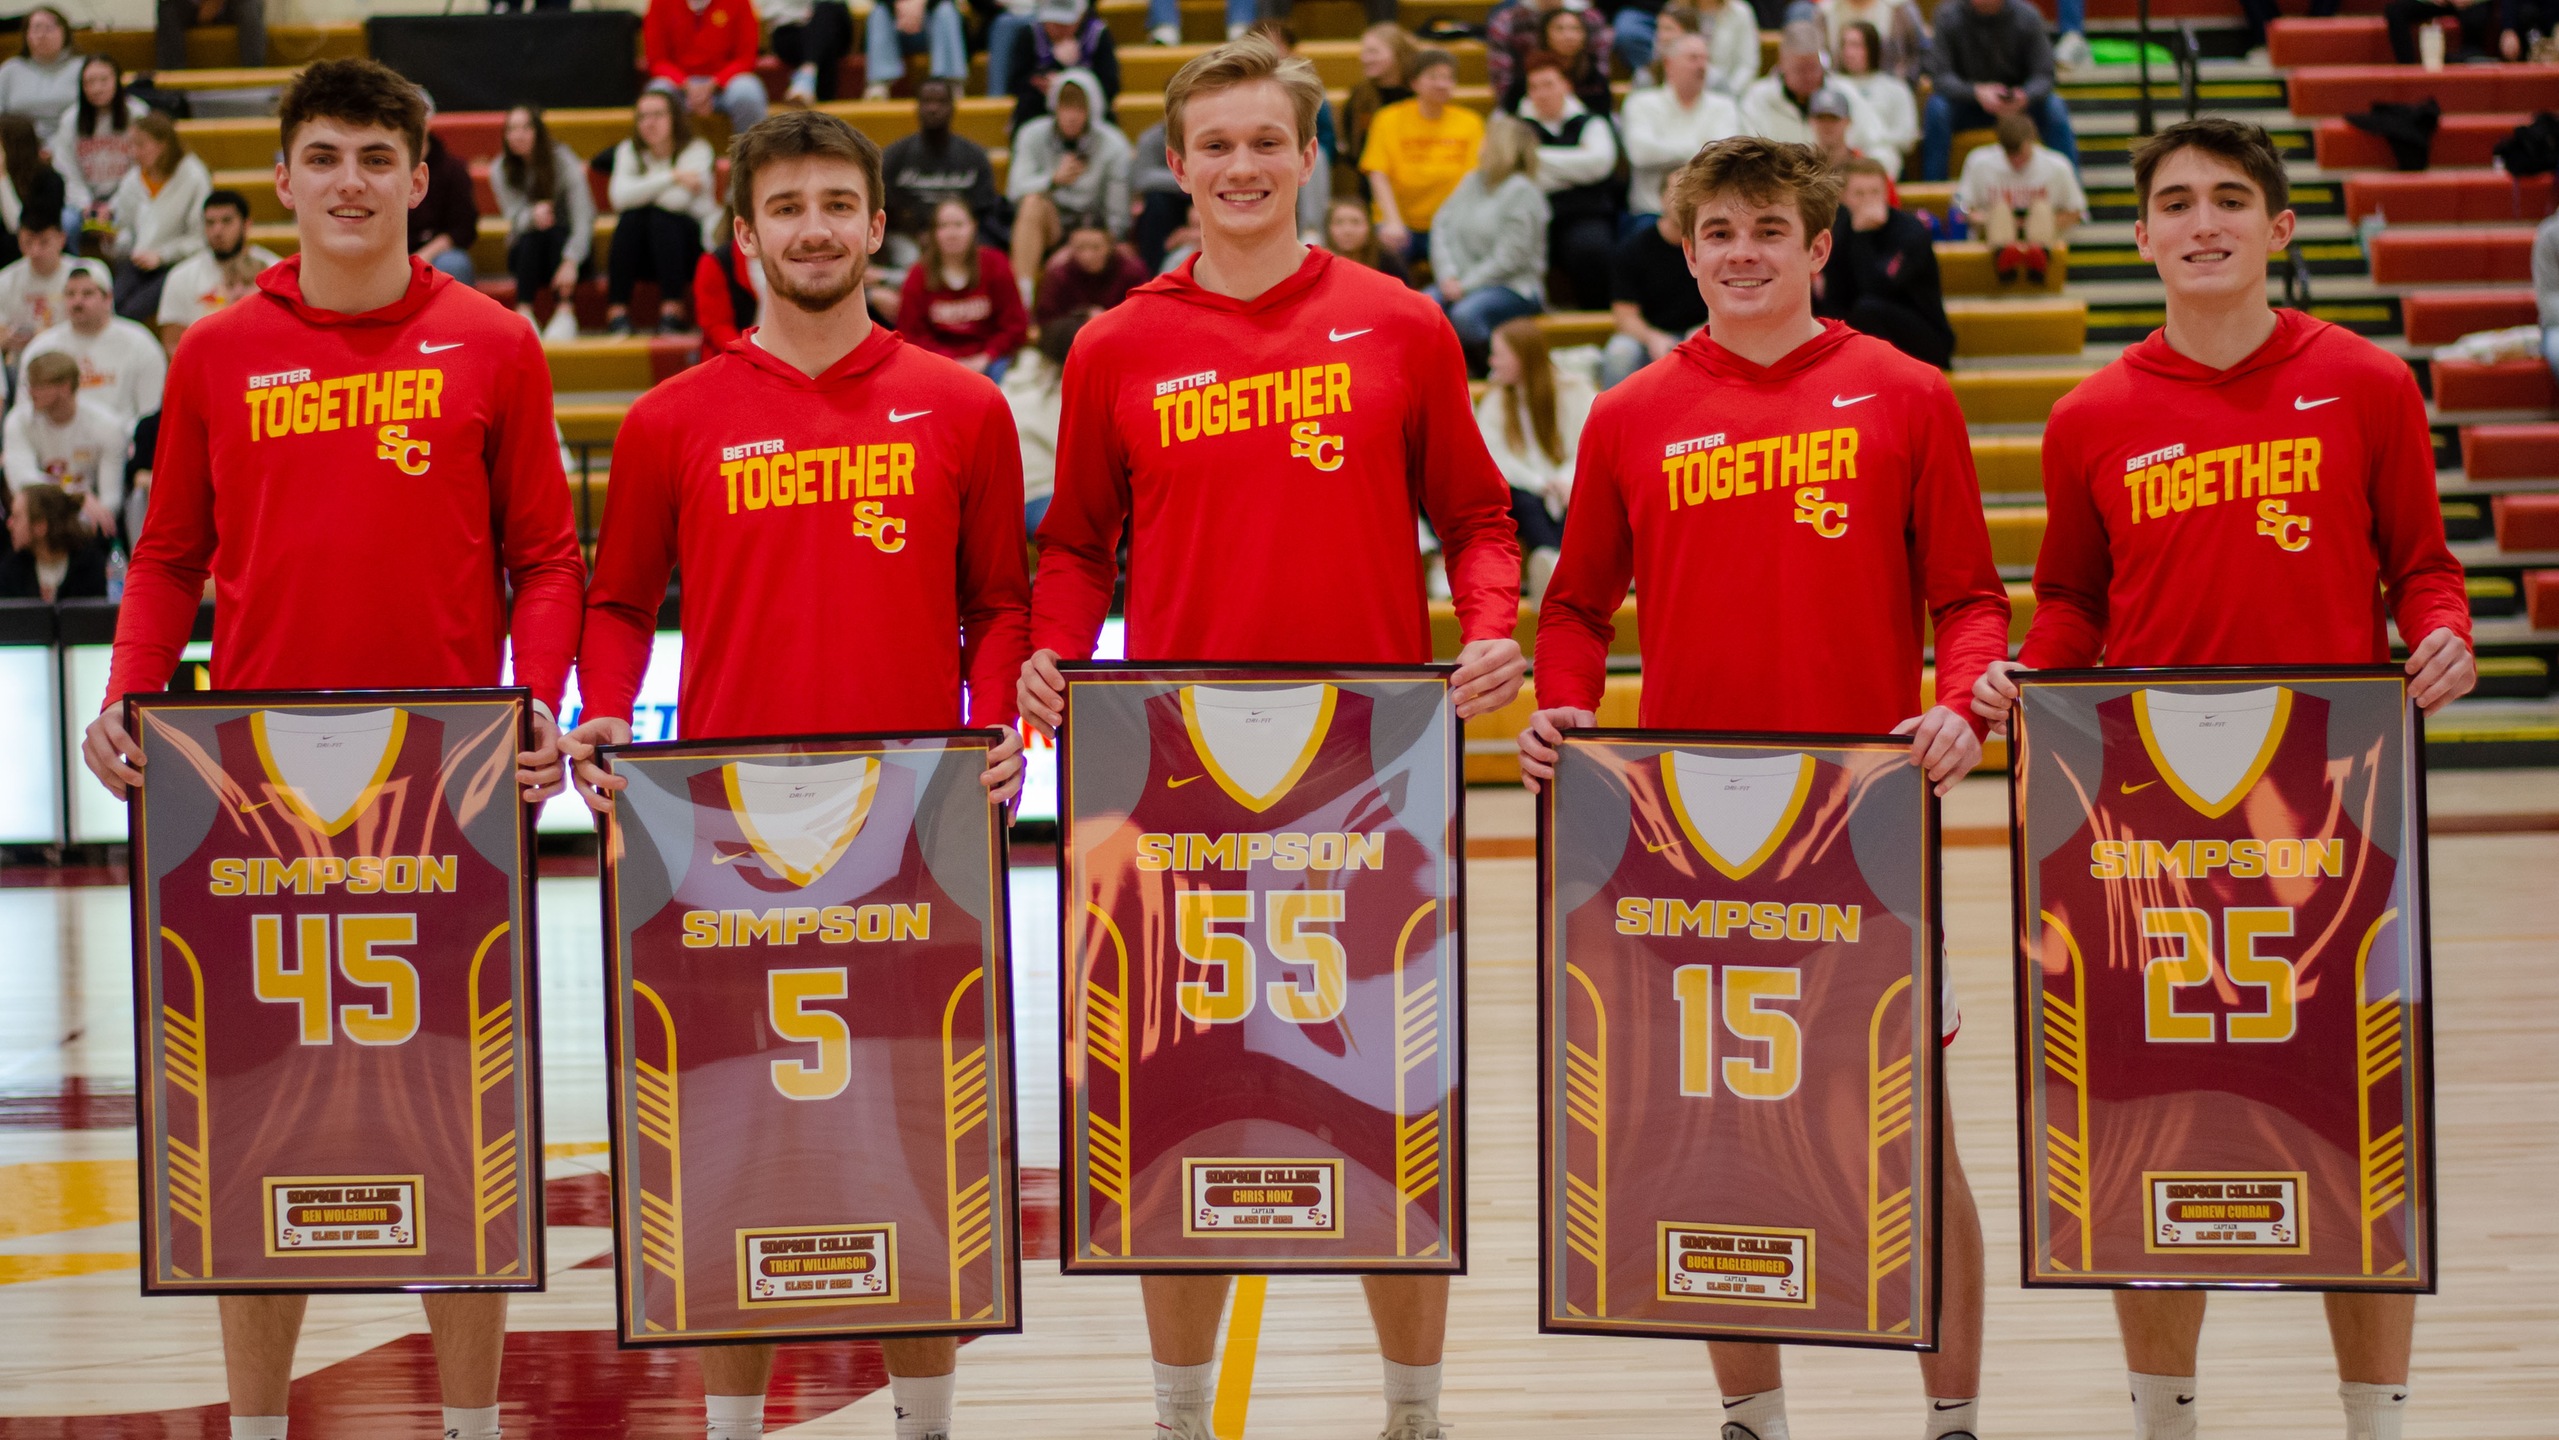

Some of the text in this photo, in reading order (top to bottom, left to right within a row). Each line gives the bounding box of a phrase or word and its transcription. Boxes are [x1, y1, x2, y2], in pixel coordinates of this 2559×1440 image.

[249, 368, 311, 389] BETTER
[1156, 370, 1217, 396] BETTER
[245, 368, 444, 442] TOGETHER
[1153, 362, 1352, 448] TOGETHER
[377, 424, 431, 476] SC
[723, 439, 784, 461] BETTER
[1290, 421, 1344, 472] SC
[1665, 433, 1725, 457] BETTER
[1662, 427, 1858, 511] TOGETHER
[2126, 443, 2185, 472] BETTER
[720, 442, 915, 514] TOGETHER
[2124, 437, 2321, 525] TOGETHER
[1794, 487, 1848, 538] SC
[853, 501, 906, 553] SC
[2256, 499, 2310, 552] SC
[1136, 832, 1385, 871] SIMPSON
[2090, 839, 2344, 879] SIMPSON
[210, 855, 458, 896] SIMPSON
[682, 902, 931, 948] SIMPSON
[1615, 897, 1861, 943] SIMPSON
[1175, 890, 1347, 1024] 55
[252, 913, 420, 1046] 45
[2142, 907, 2297, 1042] 25
[767, 967, 851, 1101] 5
[1673, 964, 1802, 1100] 15
[1233, 1190, 1293, 1203] CHRIS HONZ
[302, 1208, 387, 1223] BEN WOLGEMUTH
[1199, 1208, 1219, 1226] SC
[1233, 1215, 1259, 1225] CLASS
[1260, 1215, 1272, 1225] OF
[1307, 1208, 1327, 1226] SC
[2181, 1205, 2270, 1219] ANDREW CURRAN
[283, 1228, 302, 1246] SC
[312, 1230, 341, 1241] CLASS
[342, 1230, 355, 1241] OF
[389, 1226, 409, 1243] SC
[2161, 1223, 2181, 1242] SC
[2195, 1231, 2221, 1241] CLASS
[2223, 1231, 2234, 1241] OF
[2271, 1223, 2291, 1242] SC
[770, 1256, 867, 1273] TRENT WILLIAMSON
[1687, 1255, 1786, 1274] BUCK EAGLEBURGER
[755, 1278, 775, 1296] SC
[785, 1280, 813, 1291] CLASS
[815, 1279, 828, 1290] OF
[863, 1274, 882, 1291] SC
[1673, 1273, 1693, 1291] SC
[1706, 1281, 1732, 1292] CLASS
[1733, 1283, 1744, 1293] OF
[1724, 1275, 1748, 1283] CAPTAIN
[1779, 1279, 1799, 1297] SC
